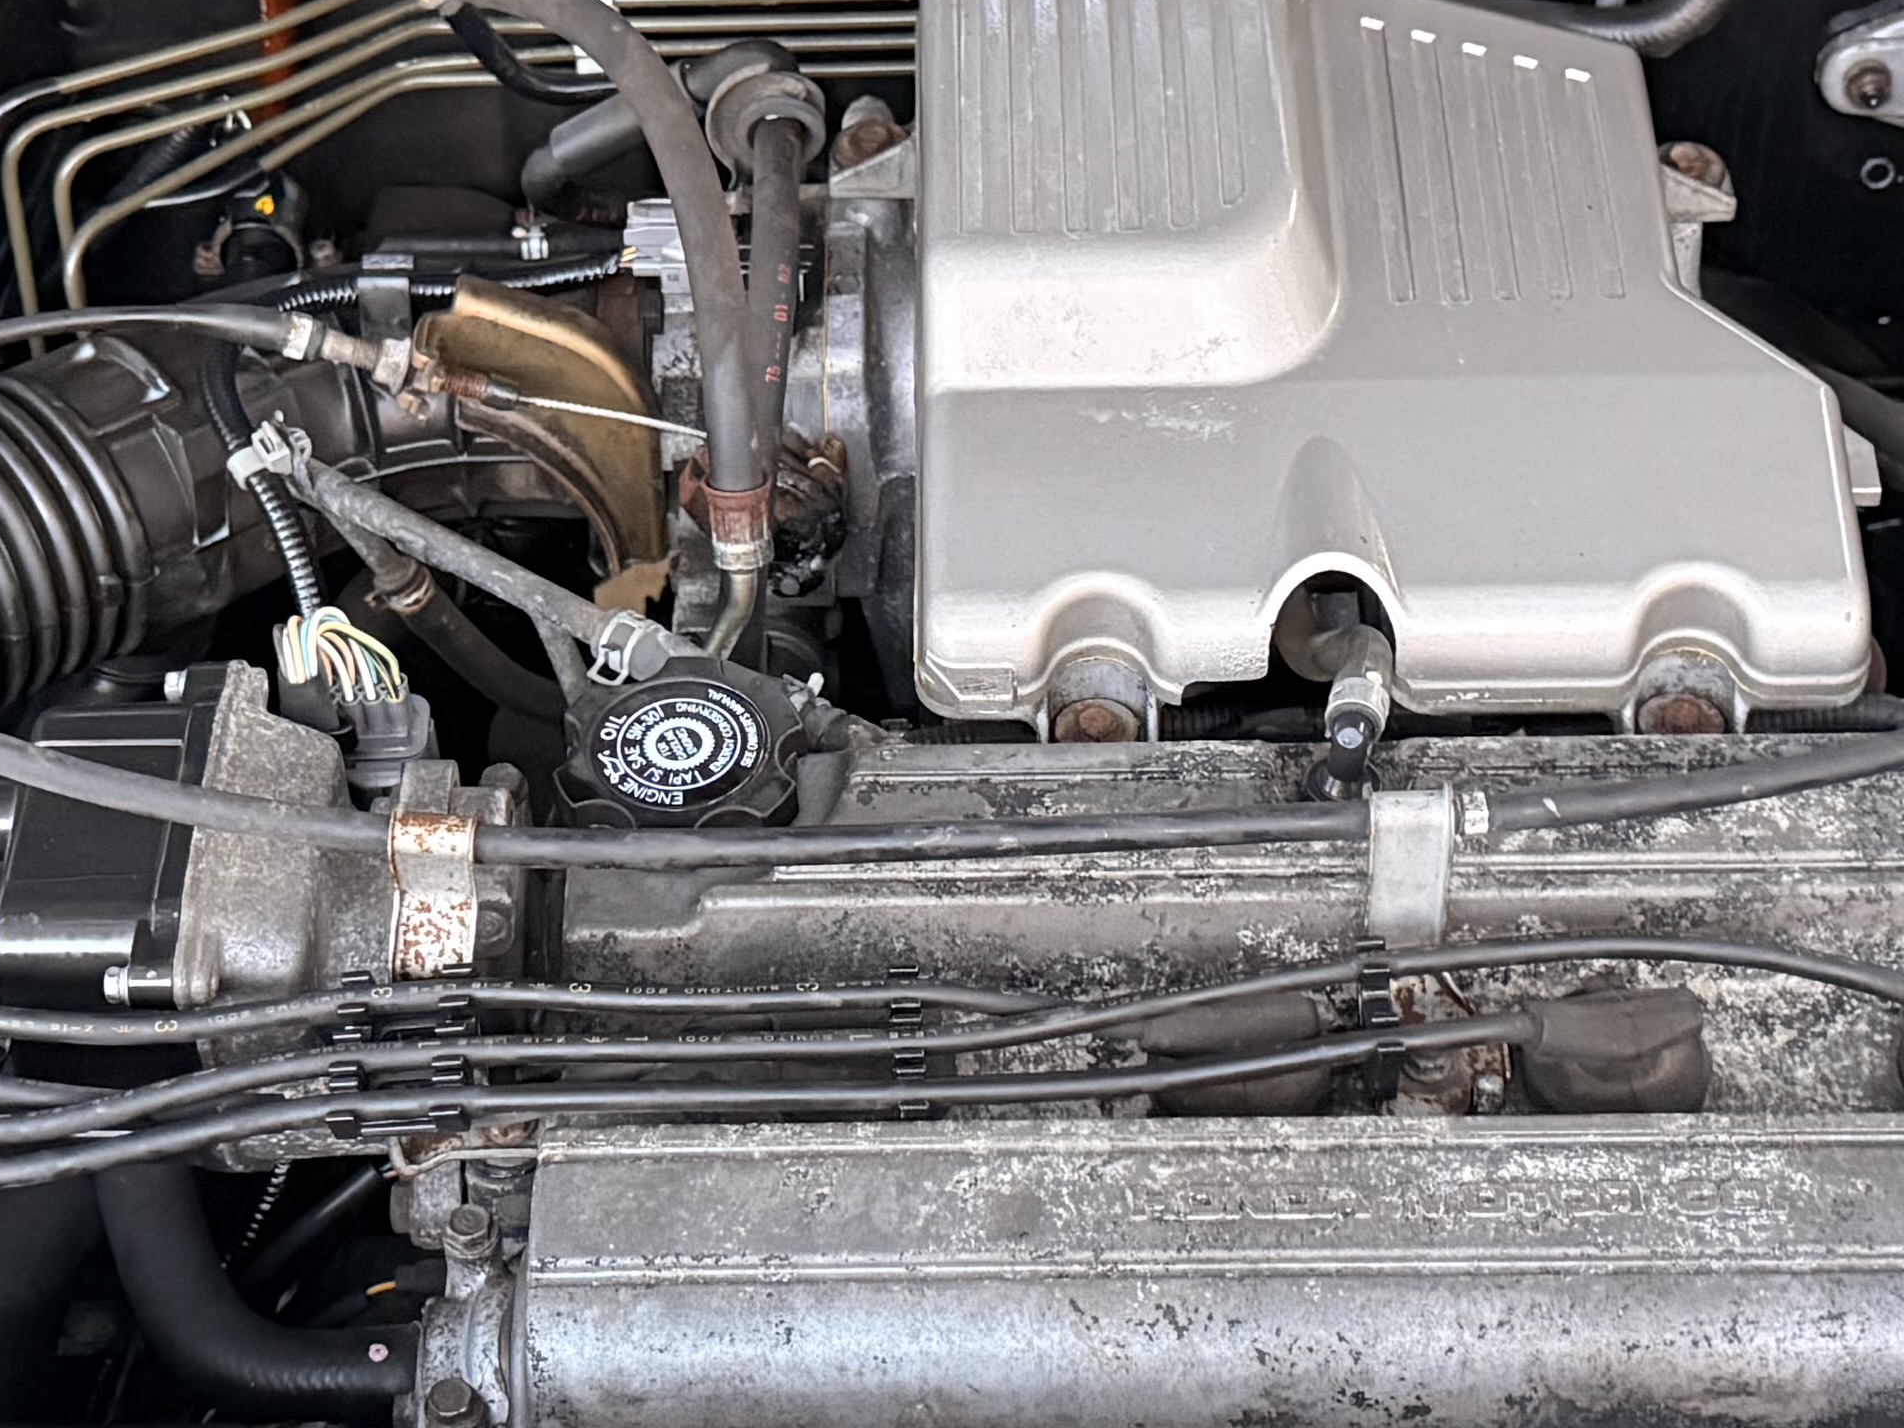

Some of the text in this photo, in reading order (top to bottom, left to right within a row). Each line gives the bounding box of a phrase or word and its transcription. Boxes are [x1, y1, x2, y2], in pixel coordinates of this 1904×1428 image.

[599, 714, 628, 740] OIL
[625, 709, 660, 741] 5W-30
[624, 744, 646, 769] SAE
[642, 767, 664, 782] SJ
[668, 770, 697, 784] API
[617, 777, 683, 805] ENGINE
